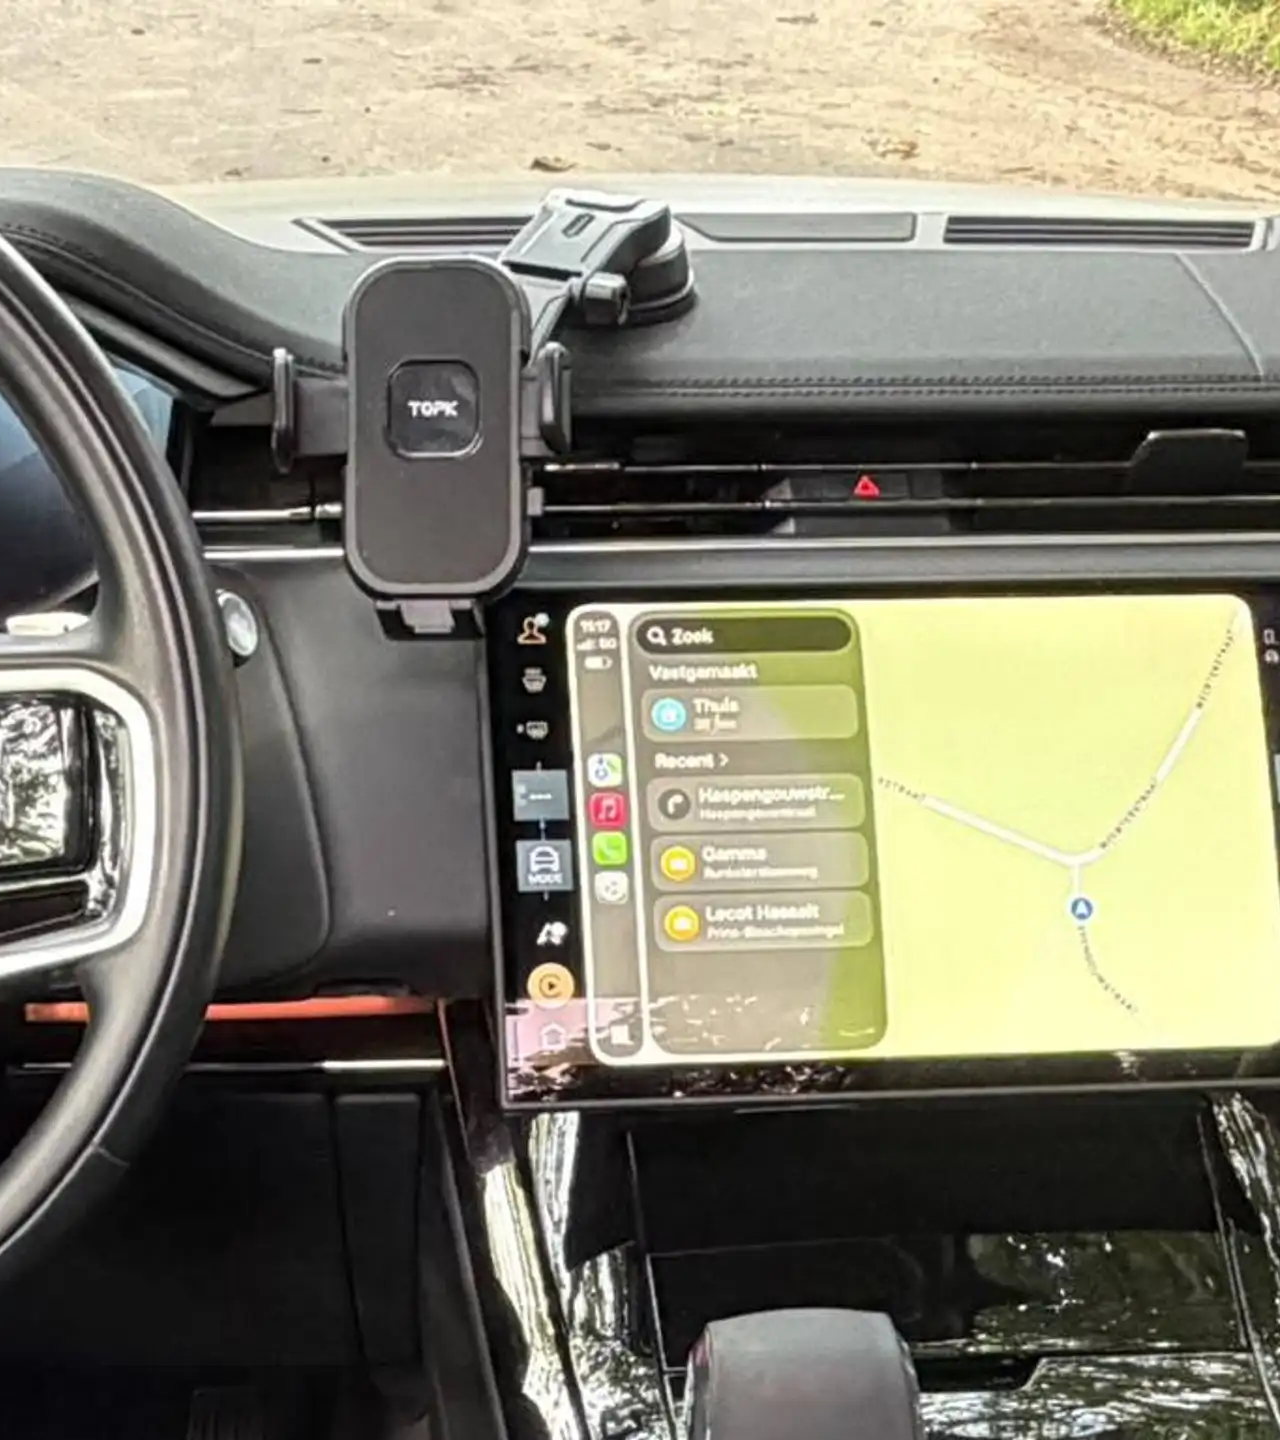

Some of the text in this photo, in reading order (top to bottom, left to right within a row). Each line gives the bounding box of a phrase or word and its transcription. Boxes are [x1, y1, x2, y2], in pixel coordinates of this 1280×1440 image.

[407, 400, 459, 418] TOPK
[670, 627, 714, 645] Zoek
[648, 662, 759, 684] Vastgemaakt
[692, 697, 740, 714] Thuis
[654, 753, 714, 770] Recent
[701, 846, 767, 863] Gamma
[528, 873, 564, 885] MODE
